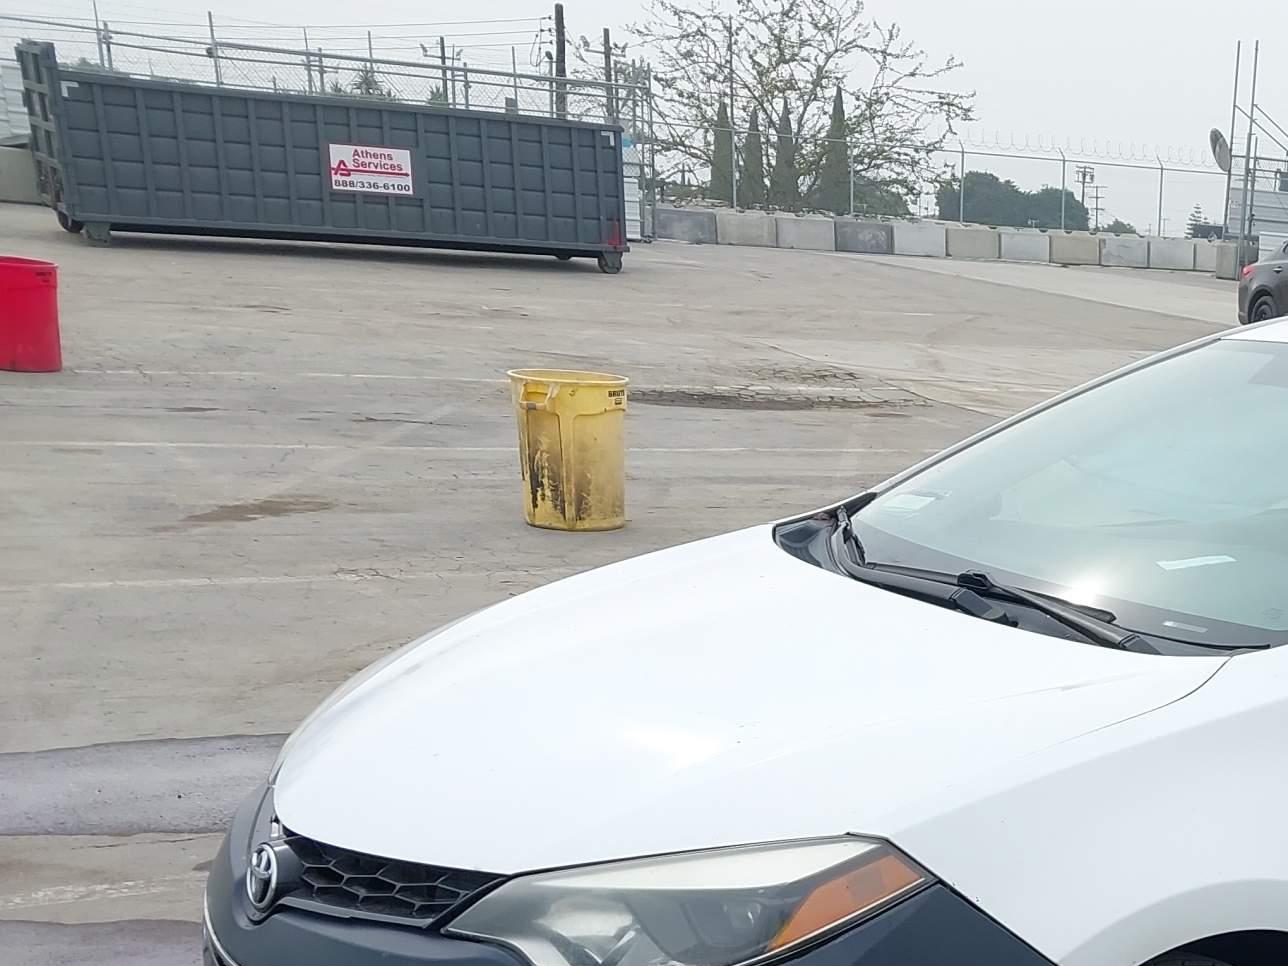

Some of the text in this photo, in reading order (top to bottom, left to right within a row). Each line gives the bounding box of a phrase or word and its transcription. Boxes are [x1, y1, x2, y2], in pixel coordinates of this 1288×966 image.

[352, 149, 393, 160] Athens
[352, 158, 403, 171] Services
[334, 180, 411, 191] 888/336-6100
